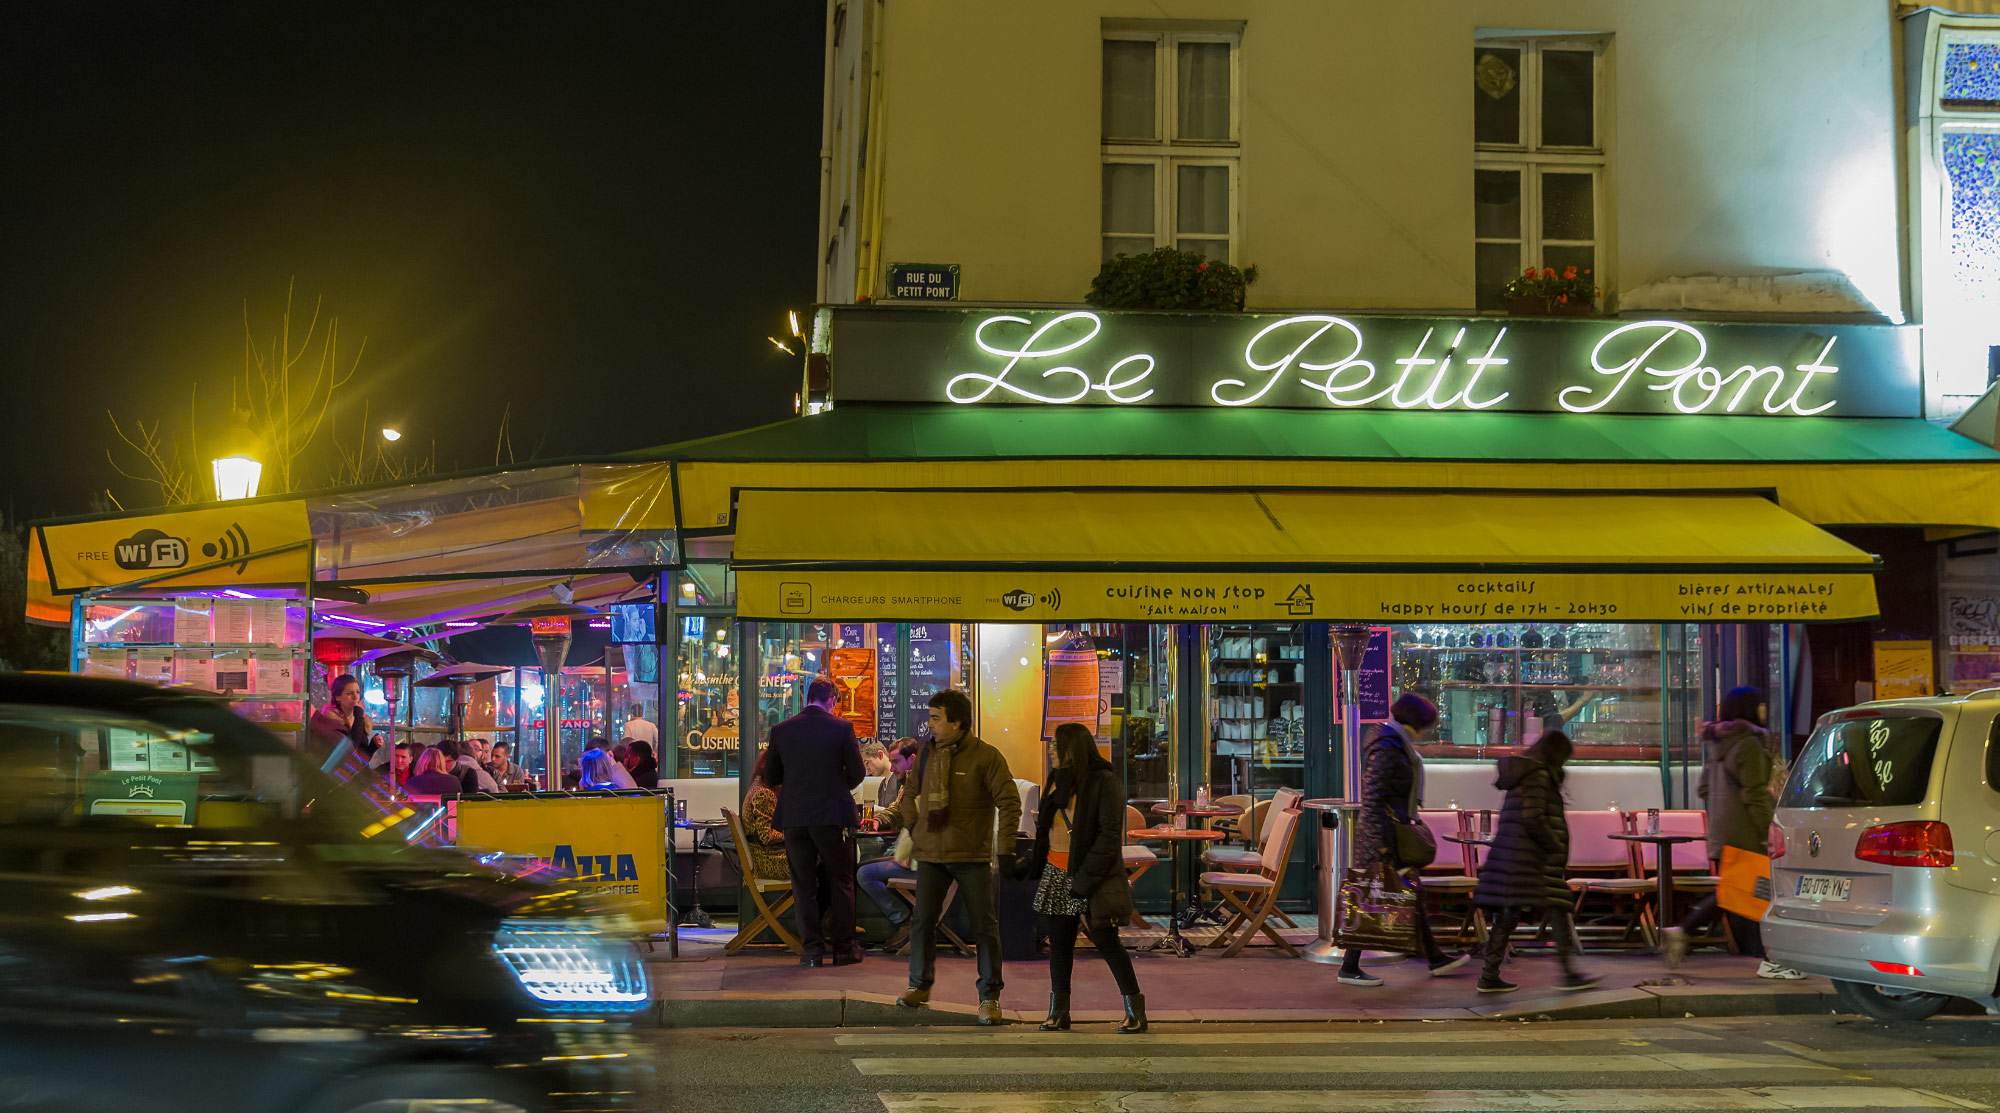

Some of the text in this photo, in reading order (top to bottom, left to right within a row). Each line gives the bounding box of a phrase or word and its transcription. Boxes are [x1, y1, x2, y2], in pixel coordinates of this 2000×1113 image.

[906, 273, 942, 284] RUE DU
[897, 286, 950, 298] PETIT PONT
[946, 311, 1839, 416] Le Petit Pont
[77, 552, 109, 561] FREE
[821, 595, 962, 606] CHARGEURS SMARTPHONE
[1494, 602, 1515, 614] de
[1720, 602, 1741, 614] de
[1747, 601, 1828, 615] propriété
[686, 729, 740, 750] CUSENIE
[131, 775, 147, 783] Petit
[147, 775, 163, 785] Pont
[596, 884, 639, 895] COFFEE
